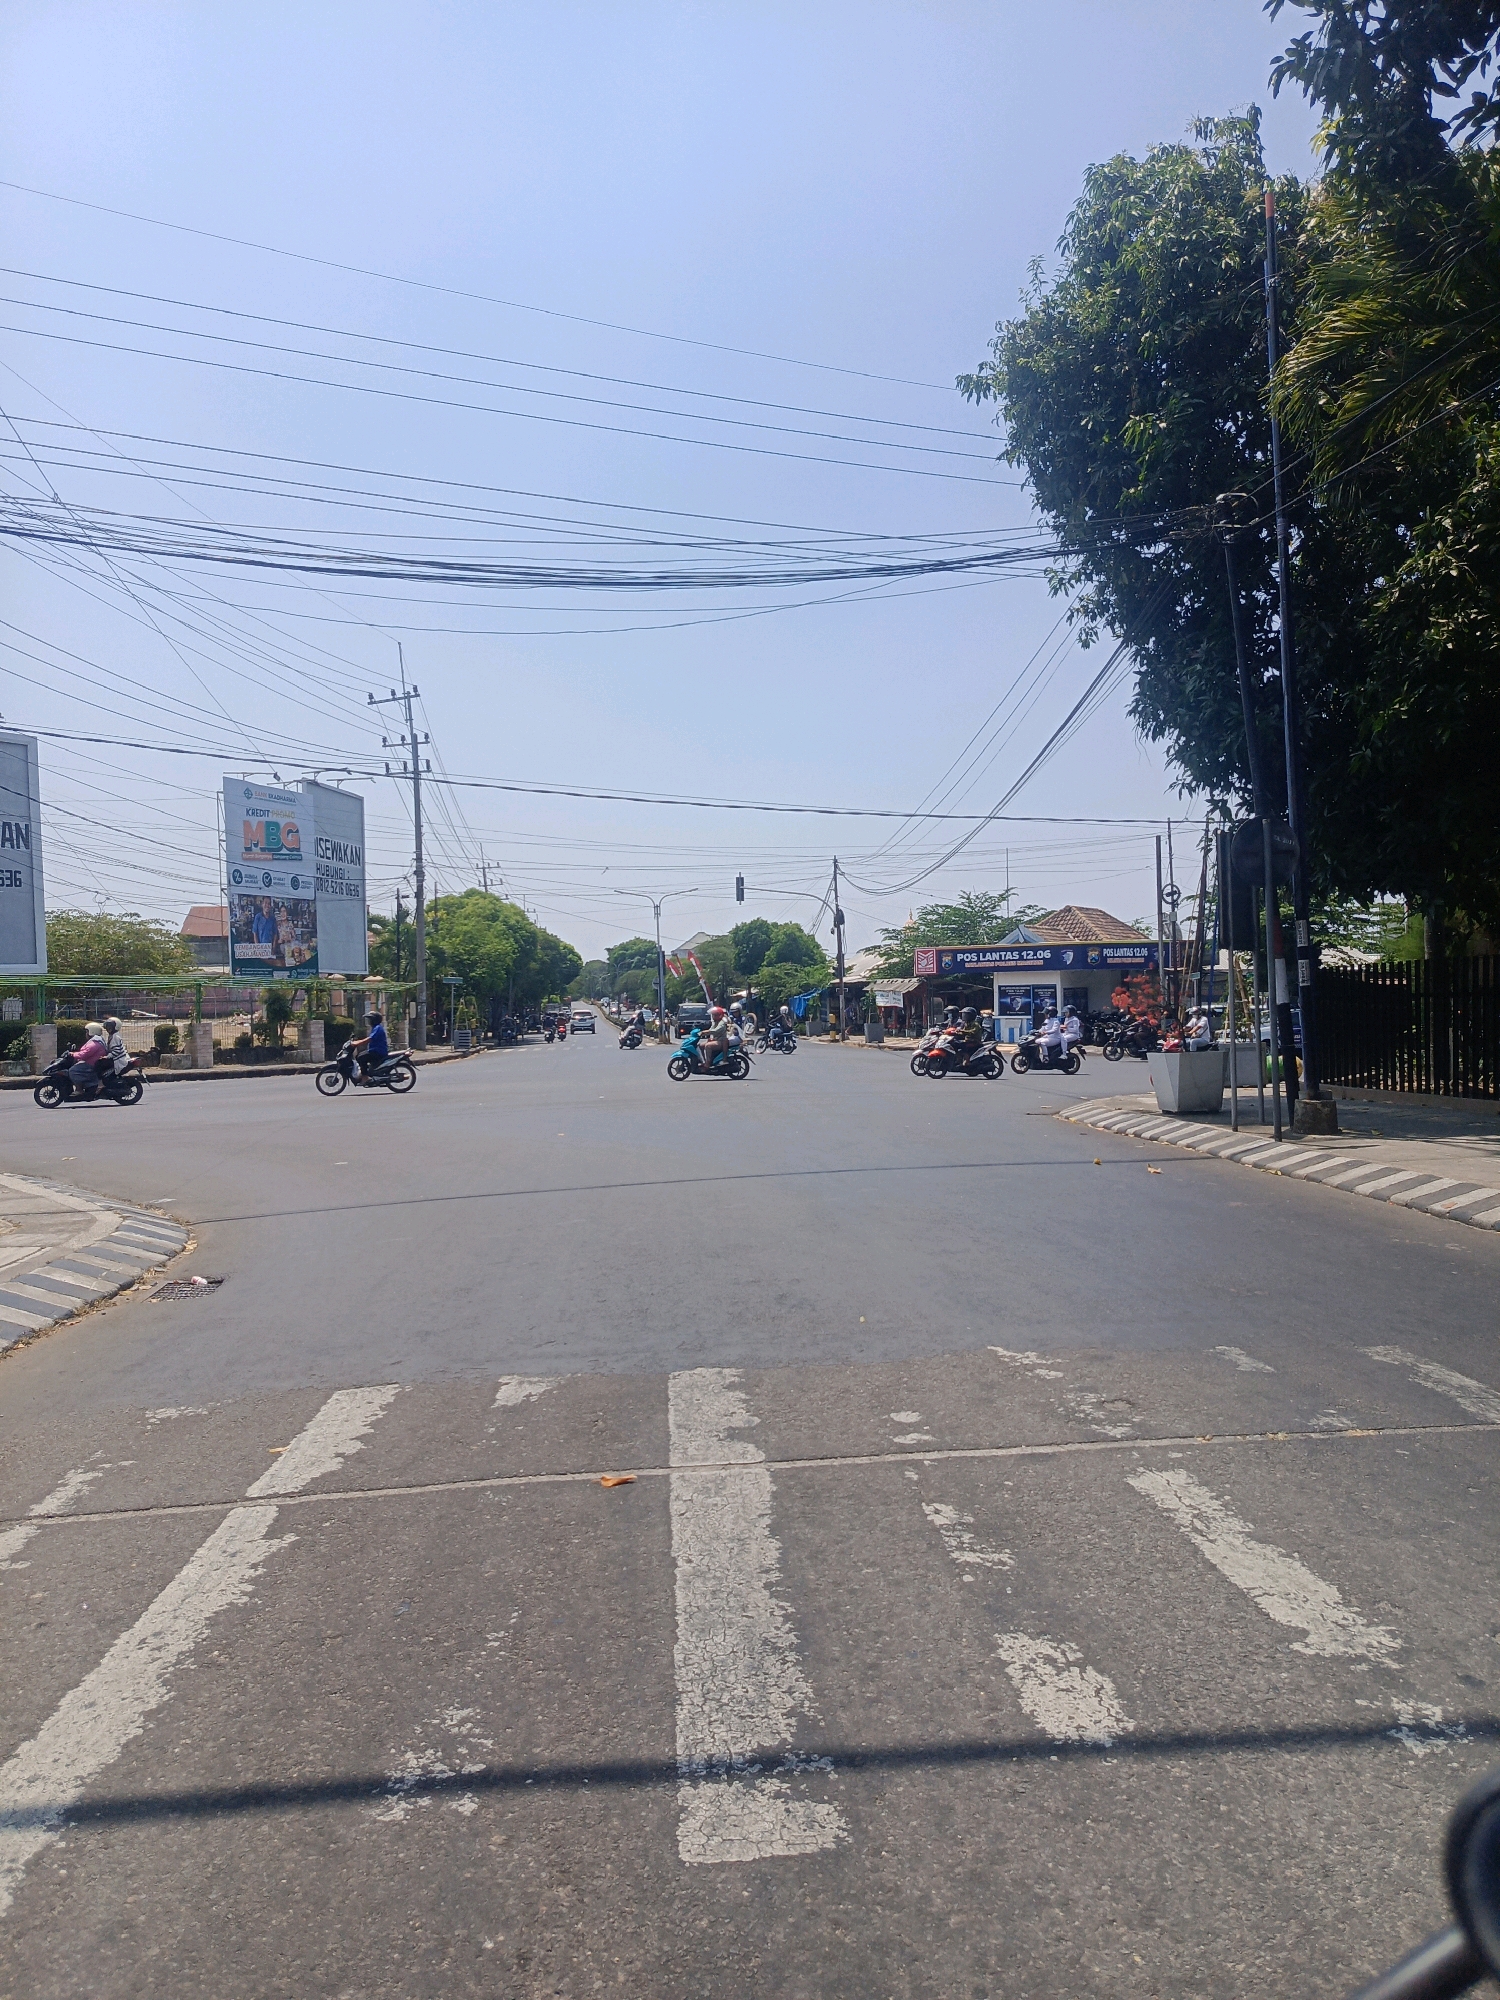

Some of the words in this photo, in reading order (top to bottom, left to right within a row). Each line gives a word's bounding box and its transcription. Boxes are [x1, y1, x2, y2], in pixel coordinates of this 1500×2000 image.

[246, 808, 270, 818] KREDIT
[243, 820, 300, 852] MBG
[314, 836, 361, 867] ISEWAKAN
[316, 862, 345, 880] HUBUNGI
[957, 952, 978, 962] POS
[980, 951, 1019, 961] LANTAS
[1021, 950, 1051, 960] 12.06
[1103, 948, 1114, 957] POS
[1113, 947, 1134, 957] LANTAS
[1134, 947, 1148, 956] 12.06
